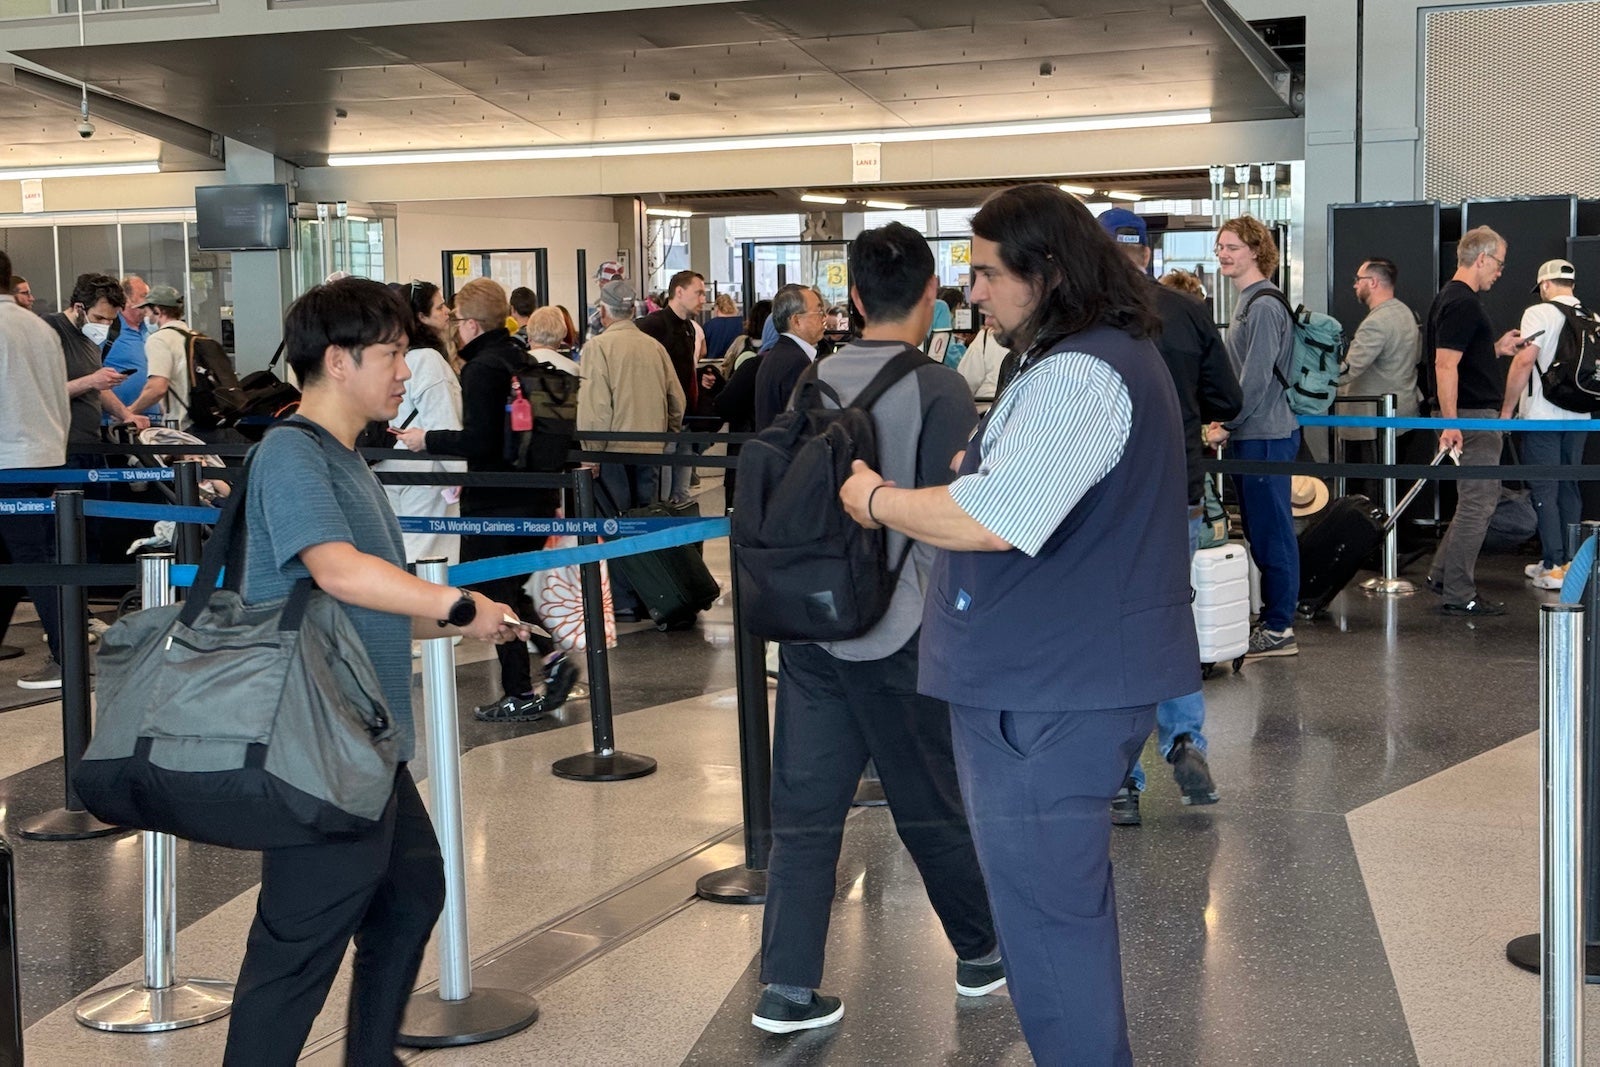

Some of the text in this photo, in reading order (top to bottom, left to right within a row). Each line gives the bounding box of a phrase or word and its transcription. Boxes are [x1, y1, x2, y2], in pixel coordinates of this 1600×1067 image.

[456, 256, 468, 275] 4
[831, 265, 842, 285] 3
[123, 471, 136, 479] TSA
[136, 470, 160, 480] Working
[17, 501, 44, 511] Canines
[429, 520, 446, 531] TSA
[447, 520, 481, 534] Working
[482, 521, 515, 532] Canines
[523, 521, 551, 533] Please
[552, 522, 565, 532] Do
[566, 522, 581, 532] Not
[583, 522, 597, 532] Pet
